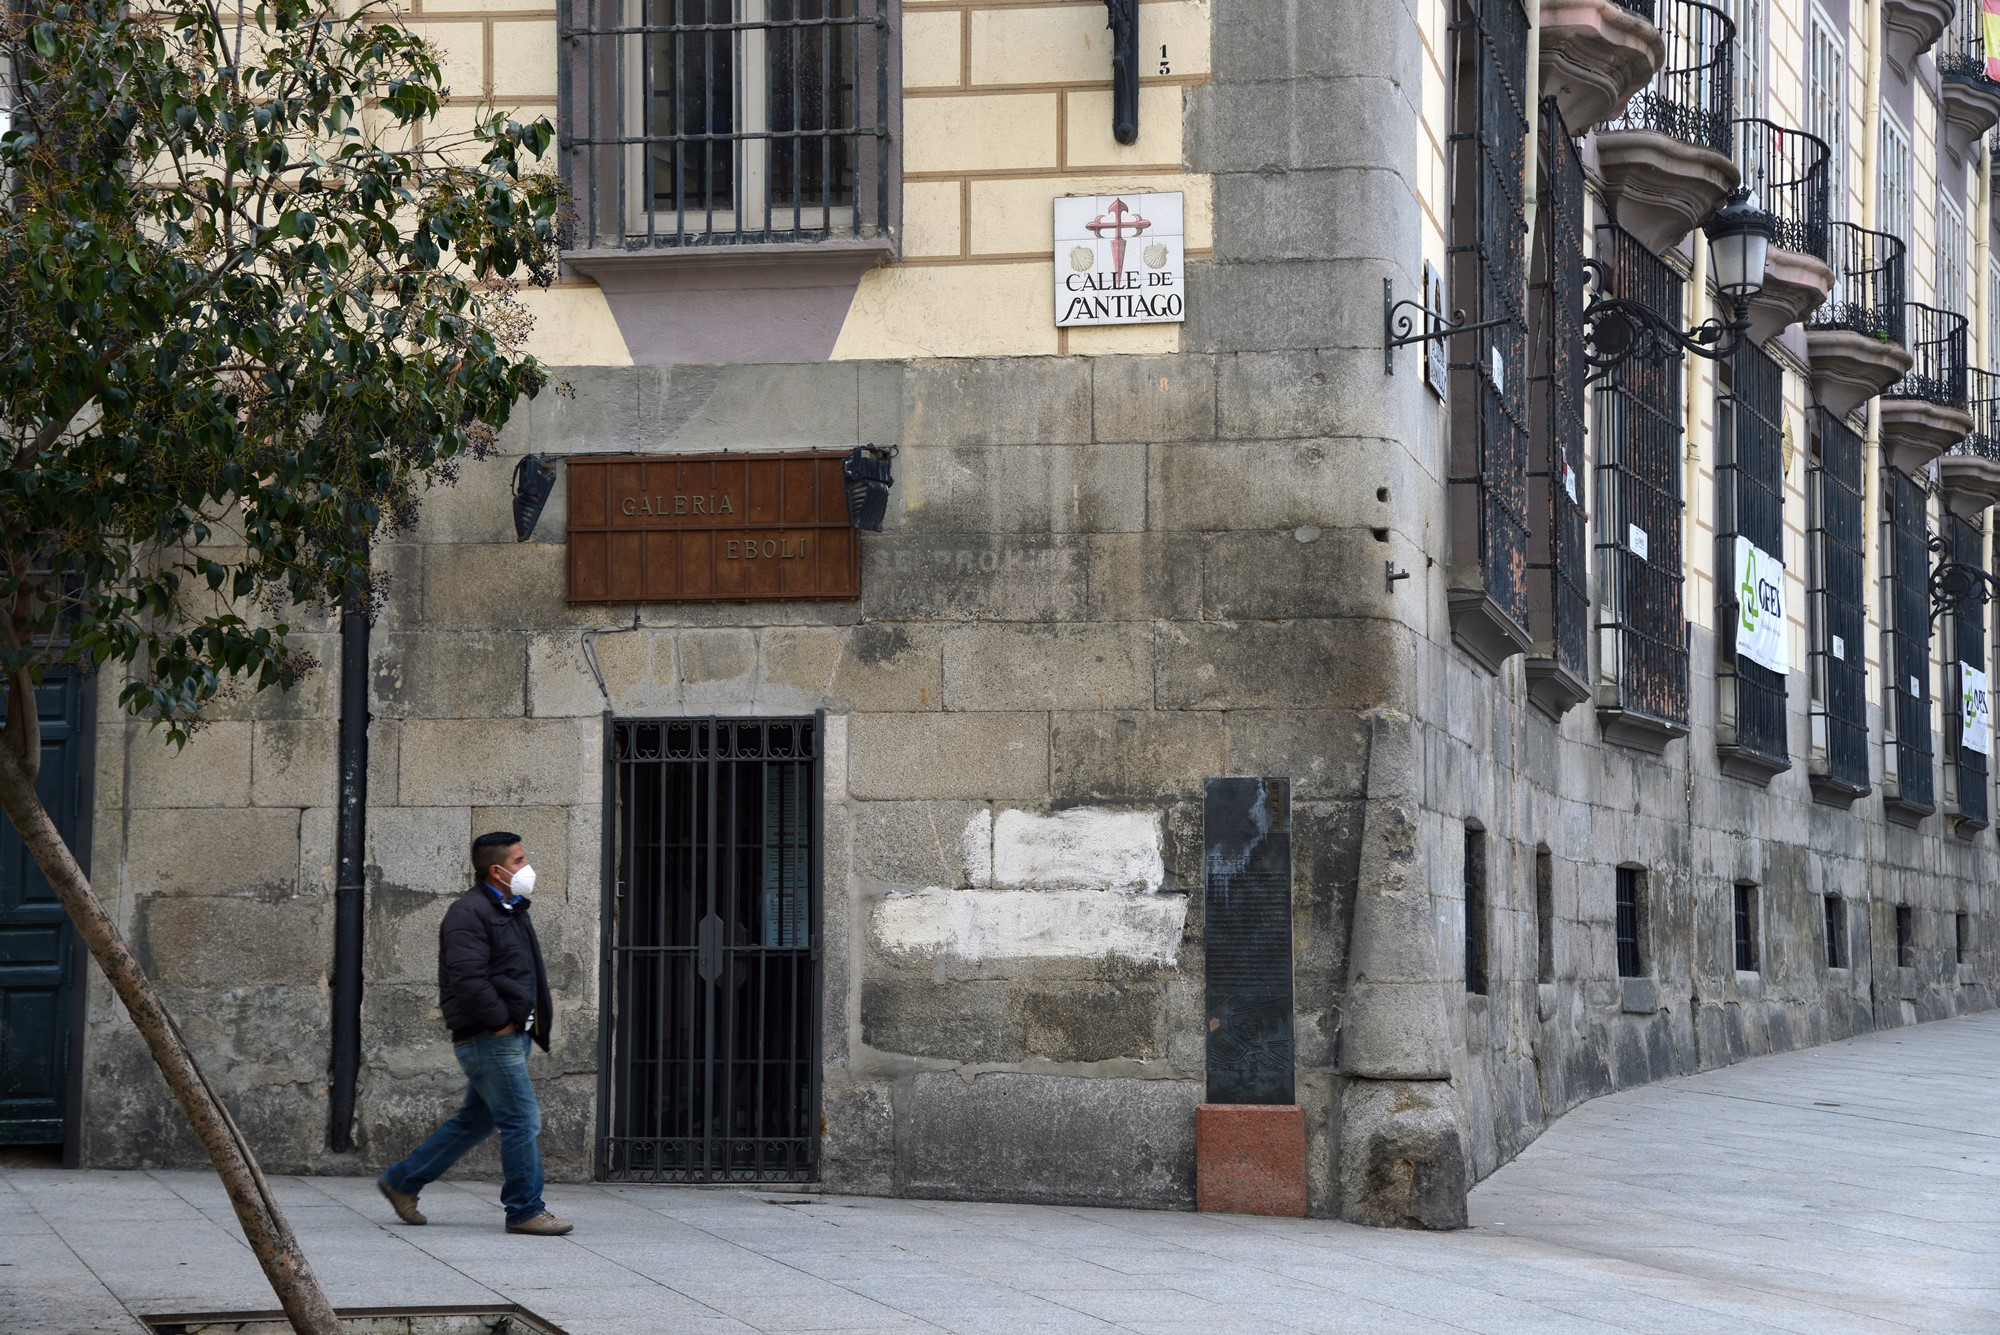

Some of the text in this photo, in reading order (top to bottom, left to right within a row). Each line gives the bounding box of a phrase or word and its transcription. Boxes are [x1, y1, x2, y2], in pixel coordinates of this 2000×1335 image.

[1066, 271, 1174, 291] CALLE DE
[1057, 293, 1182, 323] SANTIAGO
[621, 495, 734, 516] GALERIA
[726, 538, 806, 560] EBOLI
